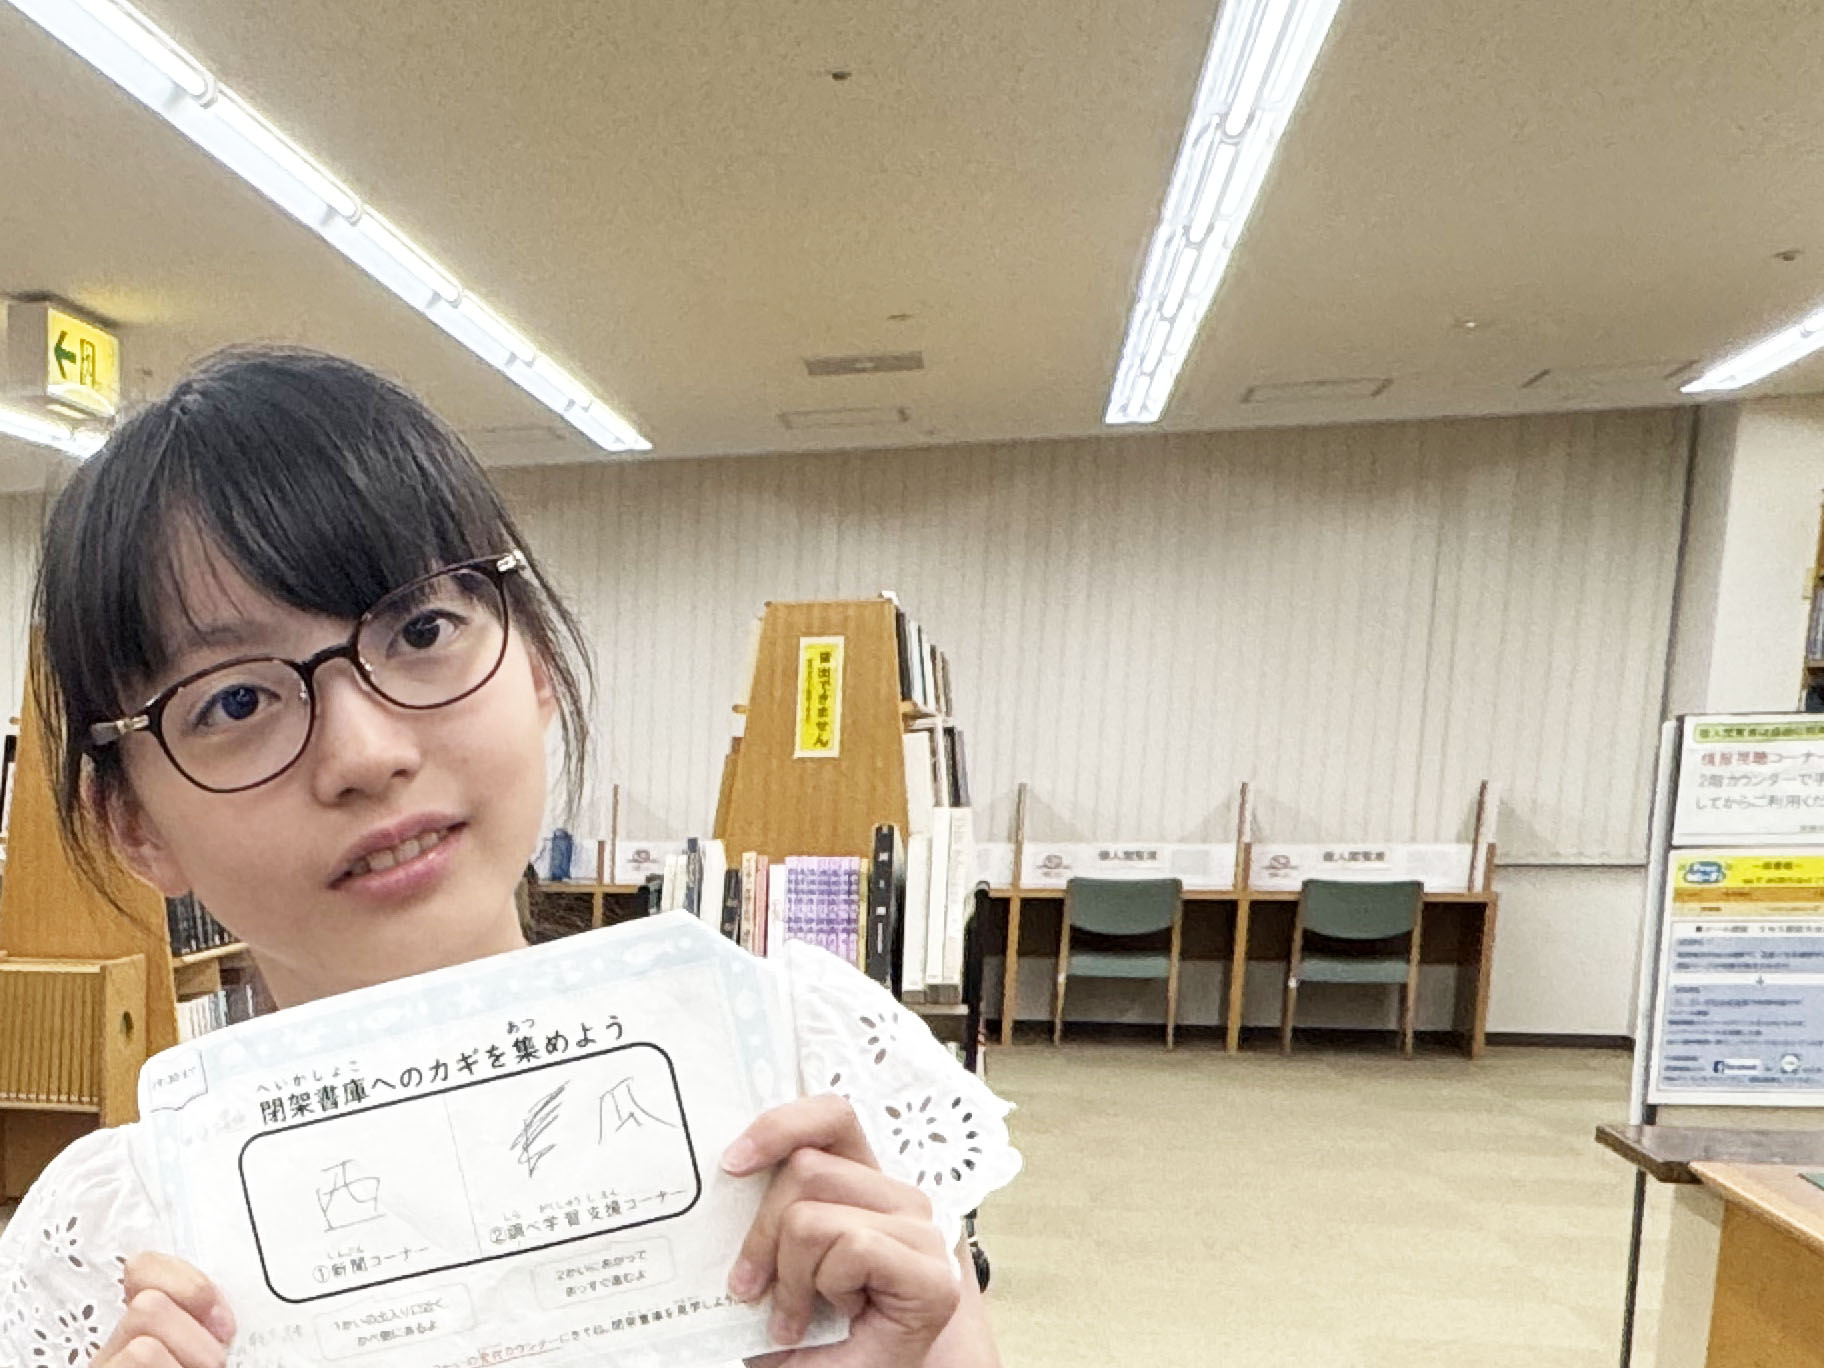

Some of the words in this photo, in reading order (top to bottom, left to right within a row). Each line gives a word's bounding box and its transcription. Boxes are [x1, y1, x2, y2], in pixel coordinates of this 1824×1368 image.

[259, 1014, 626, 1126] 閉架書庫へのカギを集めよう
